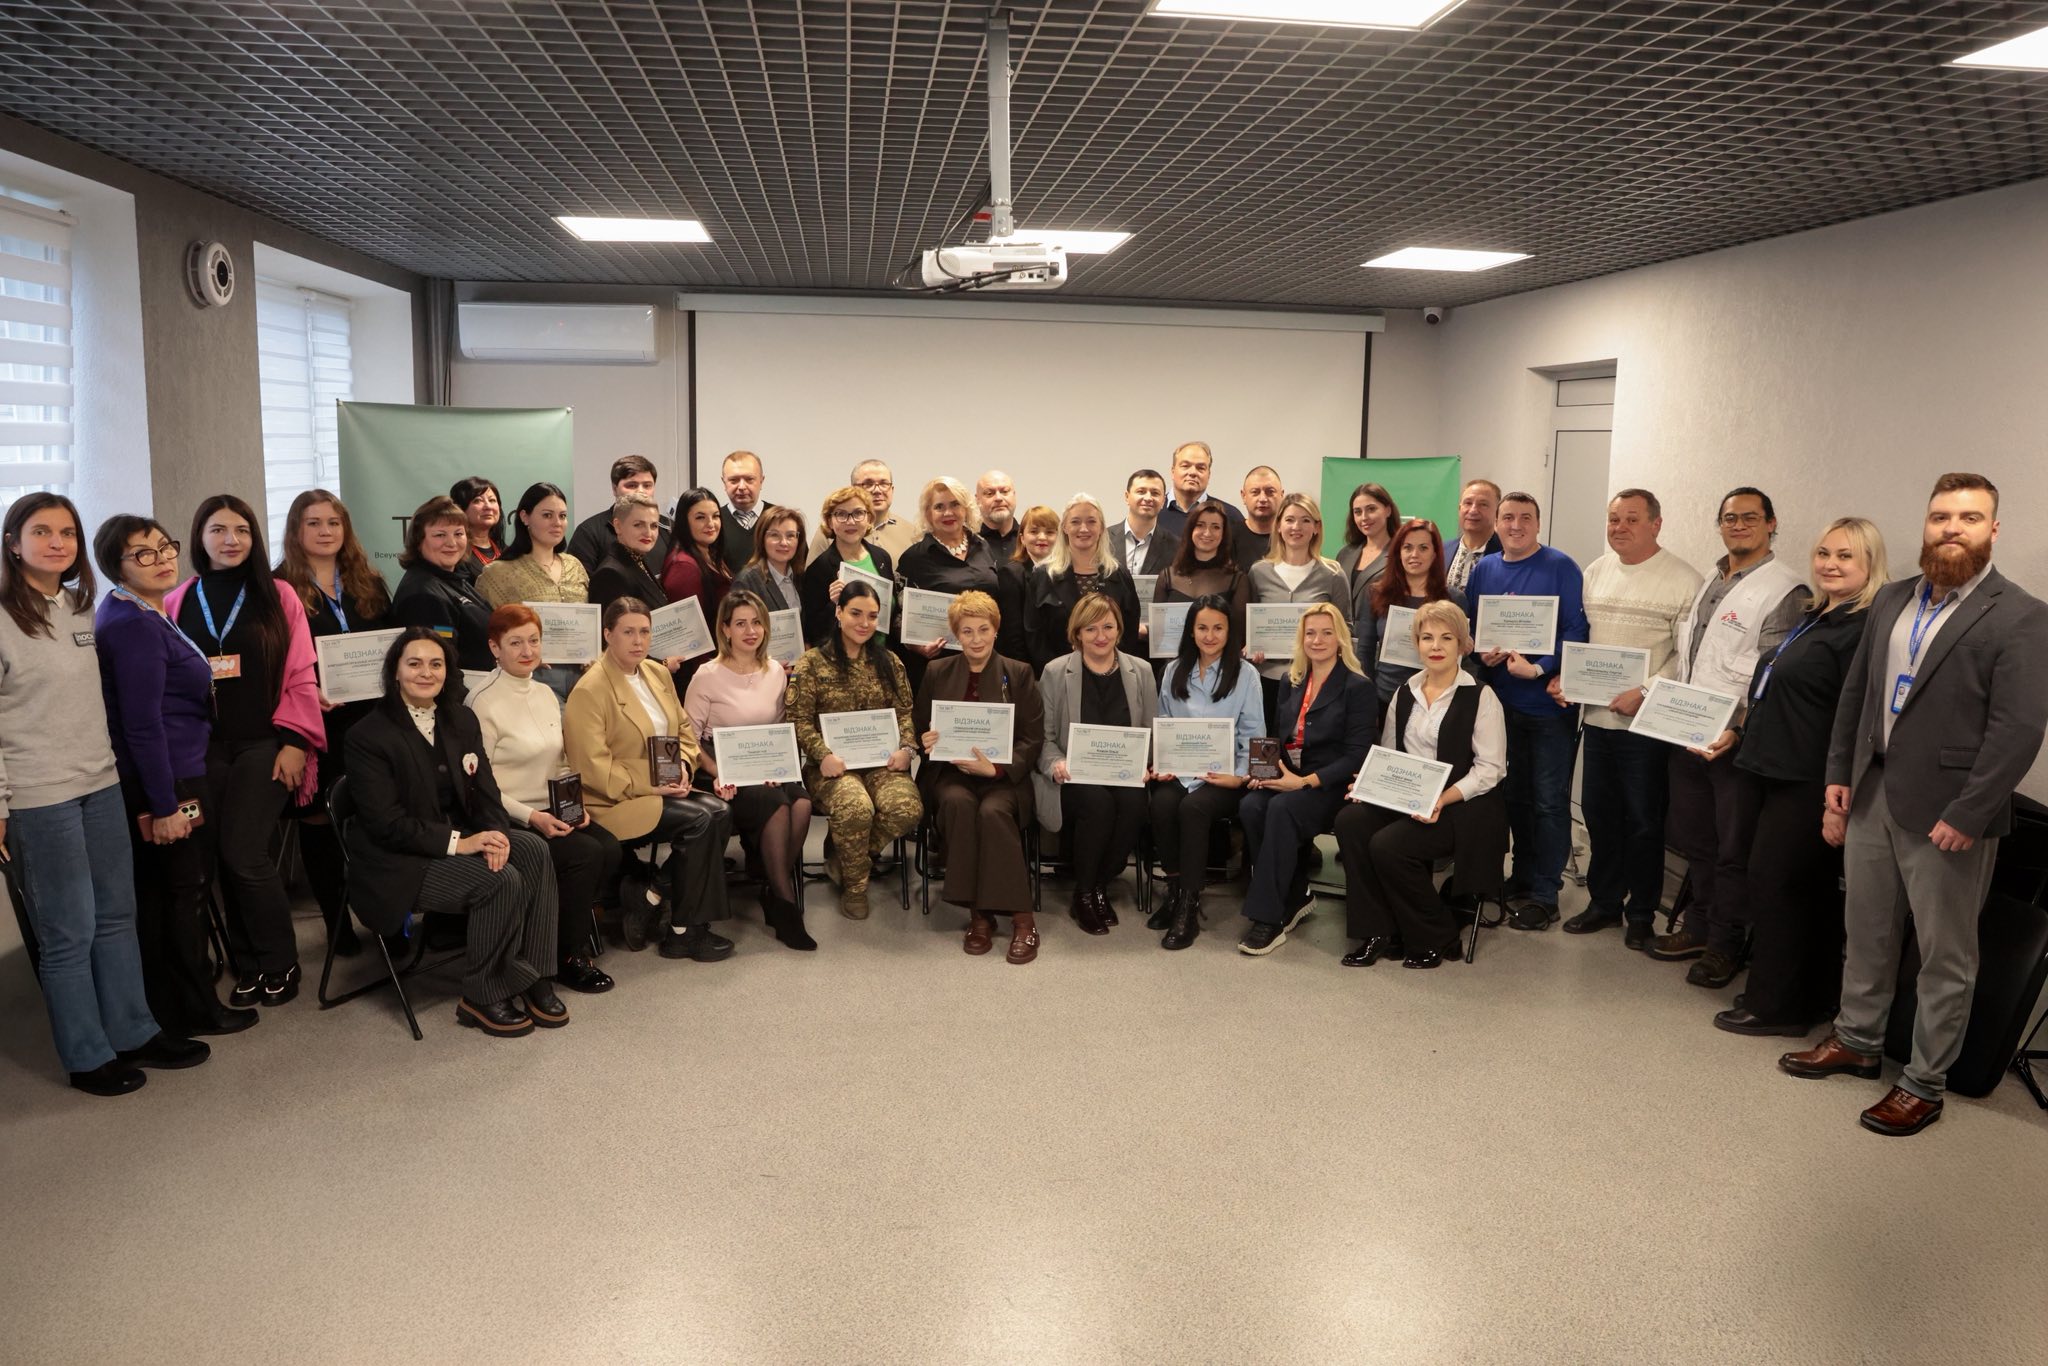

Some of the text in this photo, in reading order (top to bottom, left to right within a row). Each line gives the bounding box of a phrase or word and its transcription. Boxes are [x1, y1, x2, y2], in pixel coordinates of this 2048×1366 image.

[545, 618, 579, 627] ВІДЗНАКА
[651, 617, 683, 633] ІДЗНАКА
[344, 649, 384, 660] ВІДЗНАКА
[1586, 660, 1624, 670] ВІДЗНАКА
[1670, 697, 1708, 712] ВІДЗНАКА
[954, 717, 991, 726] ВІДЗНАКА
[844, 725, 877, 734] ВІДЗНАКА
[738, 740, 774, 749] ВІДЗНАКА
[1091, 741, 1126, 749] ВІДЗНАКА
[1386, 765, 1422, 780] ВІДЗНАКА
